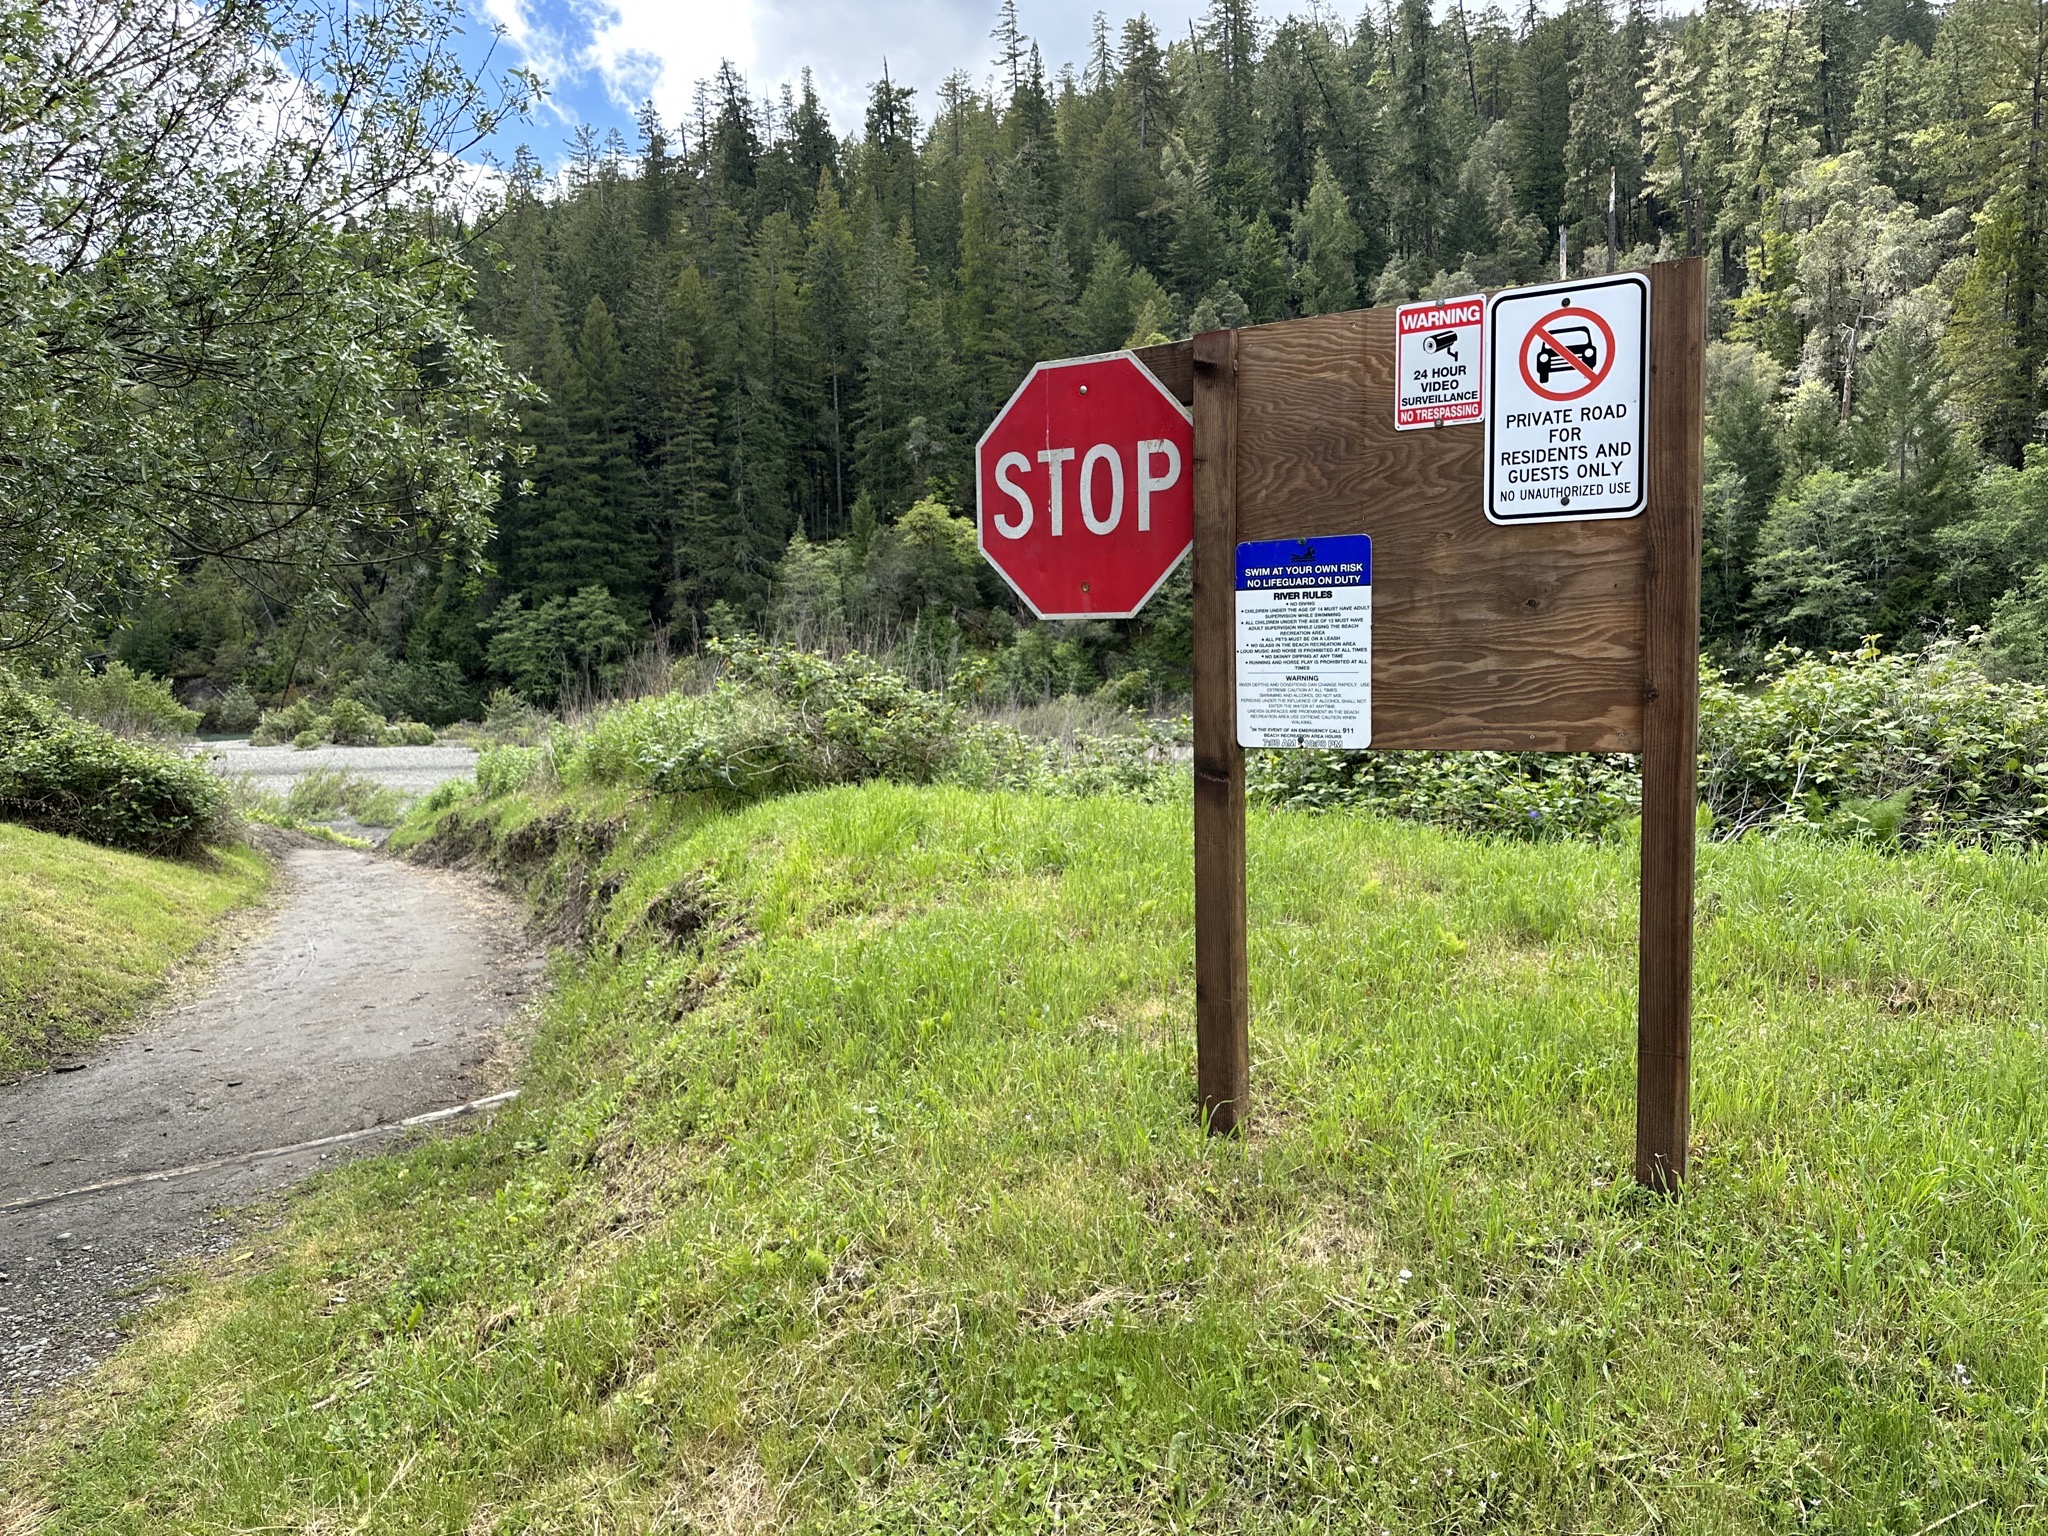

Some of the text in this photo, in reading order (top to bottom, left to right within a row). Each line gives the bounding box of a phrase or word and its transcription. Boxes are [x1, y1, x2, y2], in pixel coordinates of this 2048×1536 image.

[1401, 304, 1480, 330] WARNING
[1414, 365, 1467, 380] 24 HOUR
[1420, 380, 1459, 392] VIDEO
[1401, 390, 1478, 406] SURVEILLANCE
[1400, 403, 1478, 422] NO TRESPASSING
[1506, 404, 1627, 428] PRIVATE ROAD
[1549, 427, 1582, 444] FOR
[1501, 442, 1632, 466] RESIDENTS AND
[1508, 461, 1623, 484] GUESTS ONLY
[993, 438, 1182, 540] STOP
[1500, 482, 1631, 502] NO UNAUTHORIZED USE
[1244, 563, 1364, 577] SWIM AT YOUR OWN RISK
[1247, 575, 1361, 588] NO LIFEGUARD ON DUTY
[1274, 590, 1333, 600] RIVER RULES
